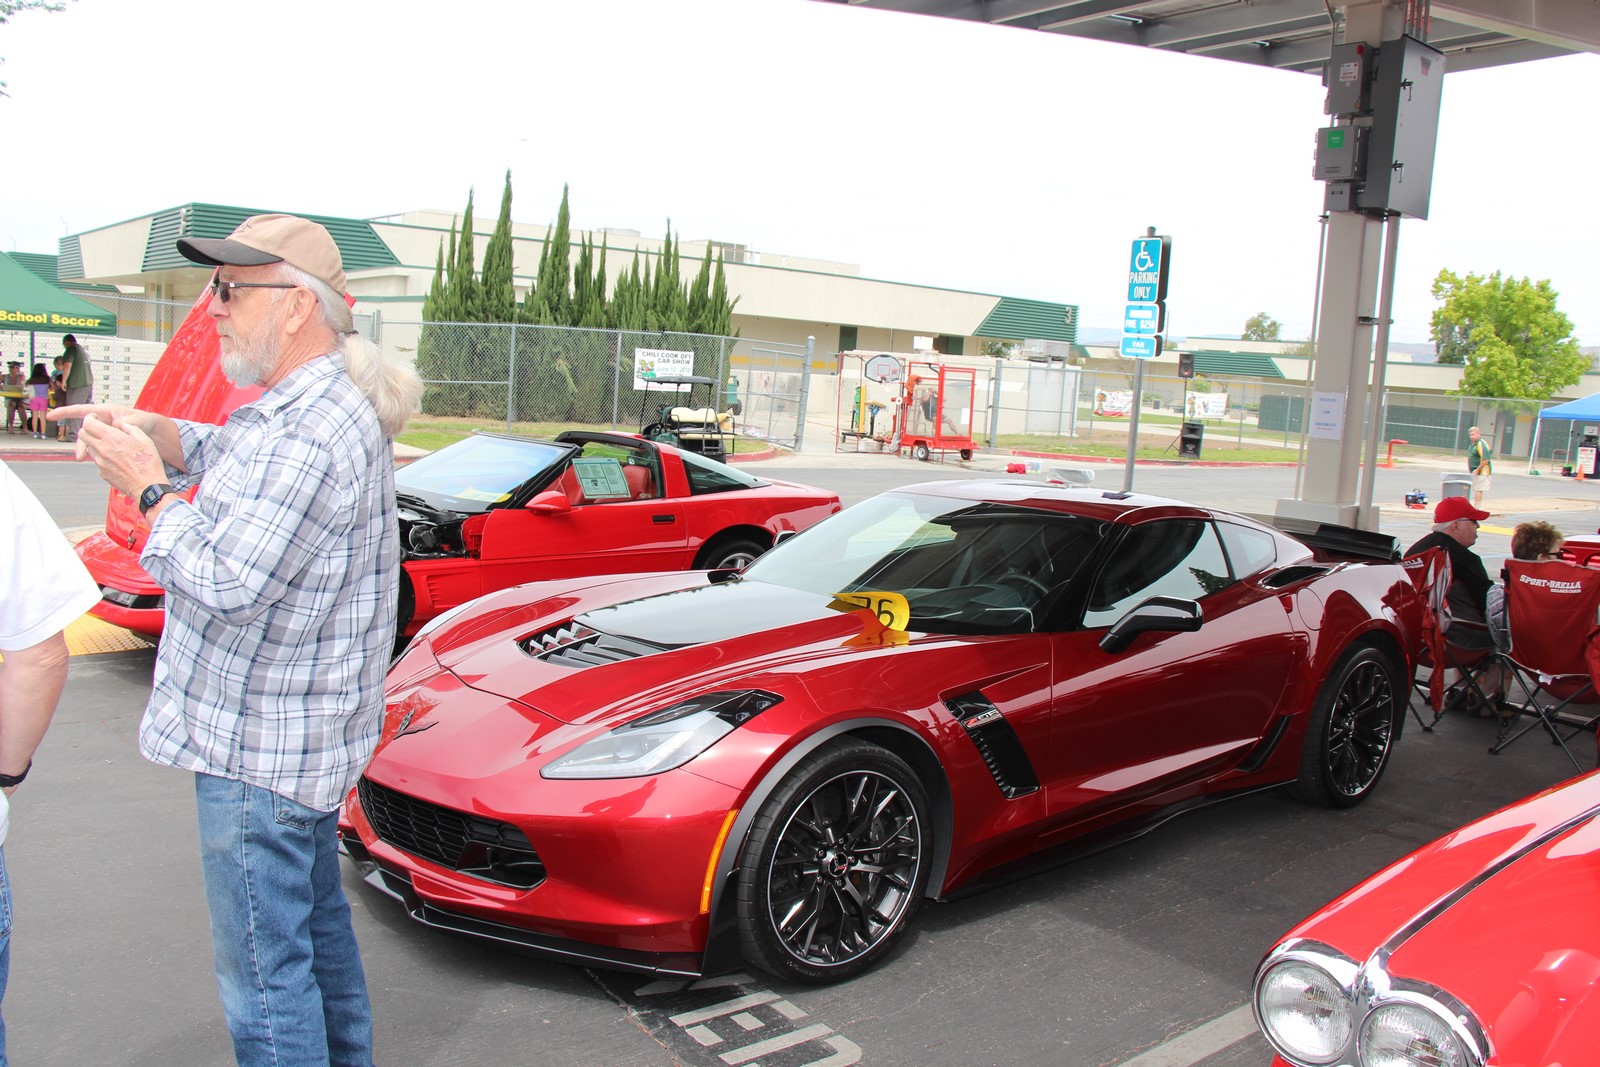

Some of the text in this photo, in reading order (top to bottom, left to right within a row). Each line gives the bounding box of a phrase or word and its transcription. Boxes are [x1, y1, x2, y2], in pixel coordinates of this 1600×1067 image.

[1130, 272, 1158, 284] PARKING
[1133, 285, 1152, 299] ONLY
[0, 310, 101, 327] School Soccer
[1064, 306, 1073, 325] 3
